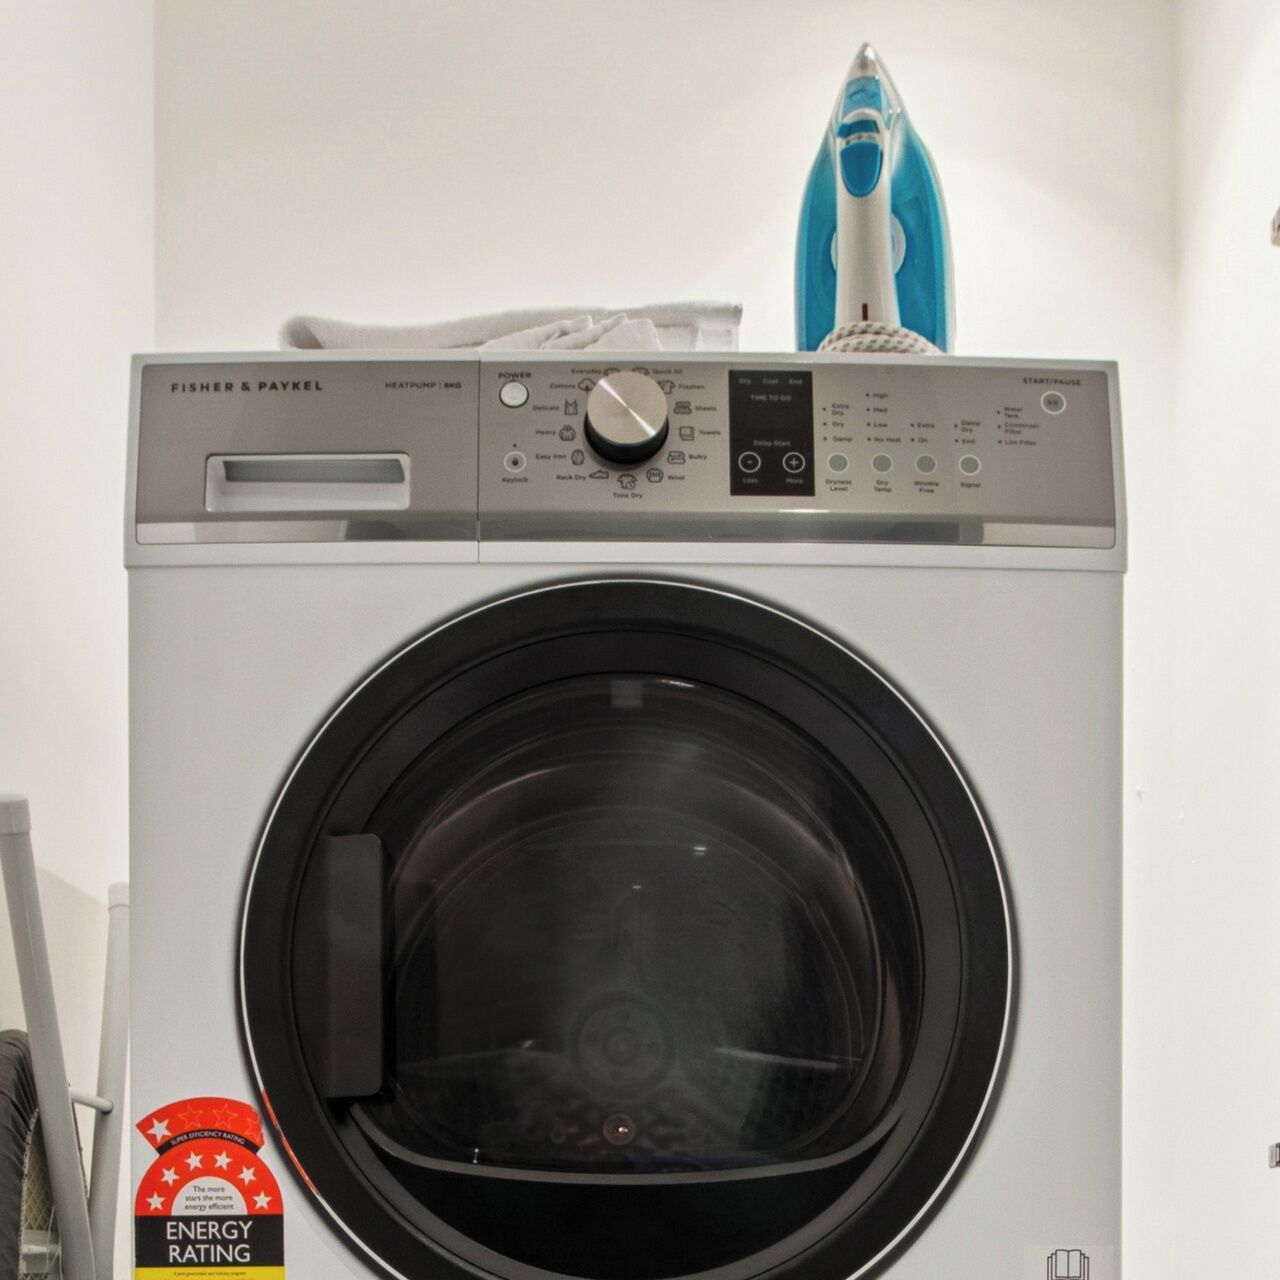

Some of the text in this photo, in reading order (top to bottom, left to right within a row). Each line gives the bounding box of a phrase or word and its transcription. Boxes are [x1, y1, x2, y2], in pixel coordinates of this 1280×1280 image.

[171, 381, 322, 392] FISHER & PAYKEL
[1022, 377, 1081, 386] START/PAUSE
[170, 1131, 246, 1146] SUPER EFFICIENCY RATING
[185, 1204, 207, 1212] energy
[166, 1221, 253, 1240] ENERGY
[169, 1244, 251, 1263] RATING
